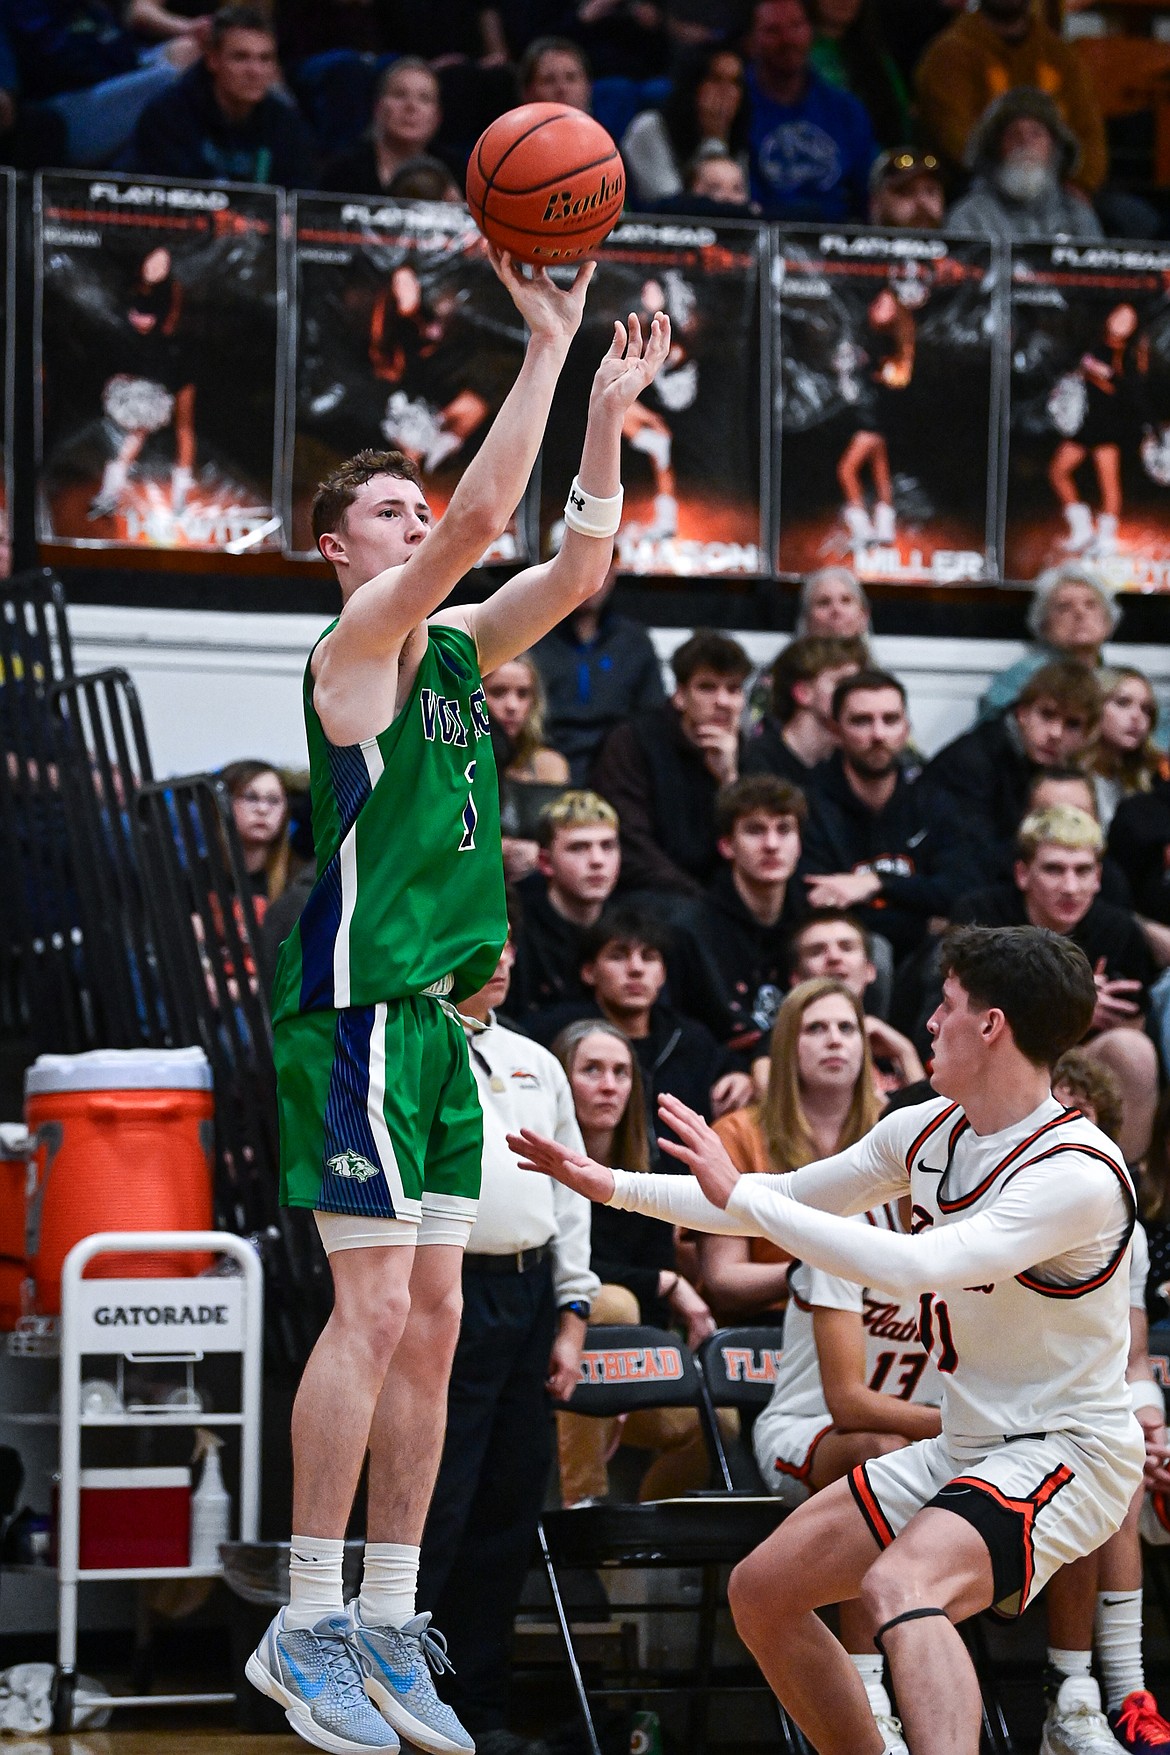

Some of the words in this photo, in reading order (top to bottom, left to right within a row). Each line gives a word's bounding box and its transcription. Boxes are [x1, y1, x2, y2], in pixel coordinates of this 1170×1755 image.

[89, 182, 230, 211] FLATHEAD
[541, 174, 622, 223] Baden
[819, 234, 949, 260] FLATHEAD
[855, 547, 985, 582] MILLER
[93, 1305, 229, 1326] GATORADE
[919, 1292, 959, 1375] 11
[868, 1352, 930, 1402] 13
